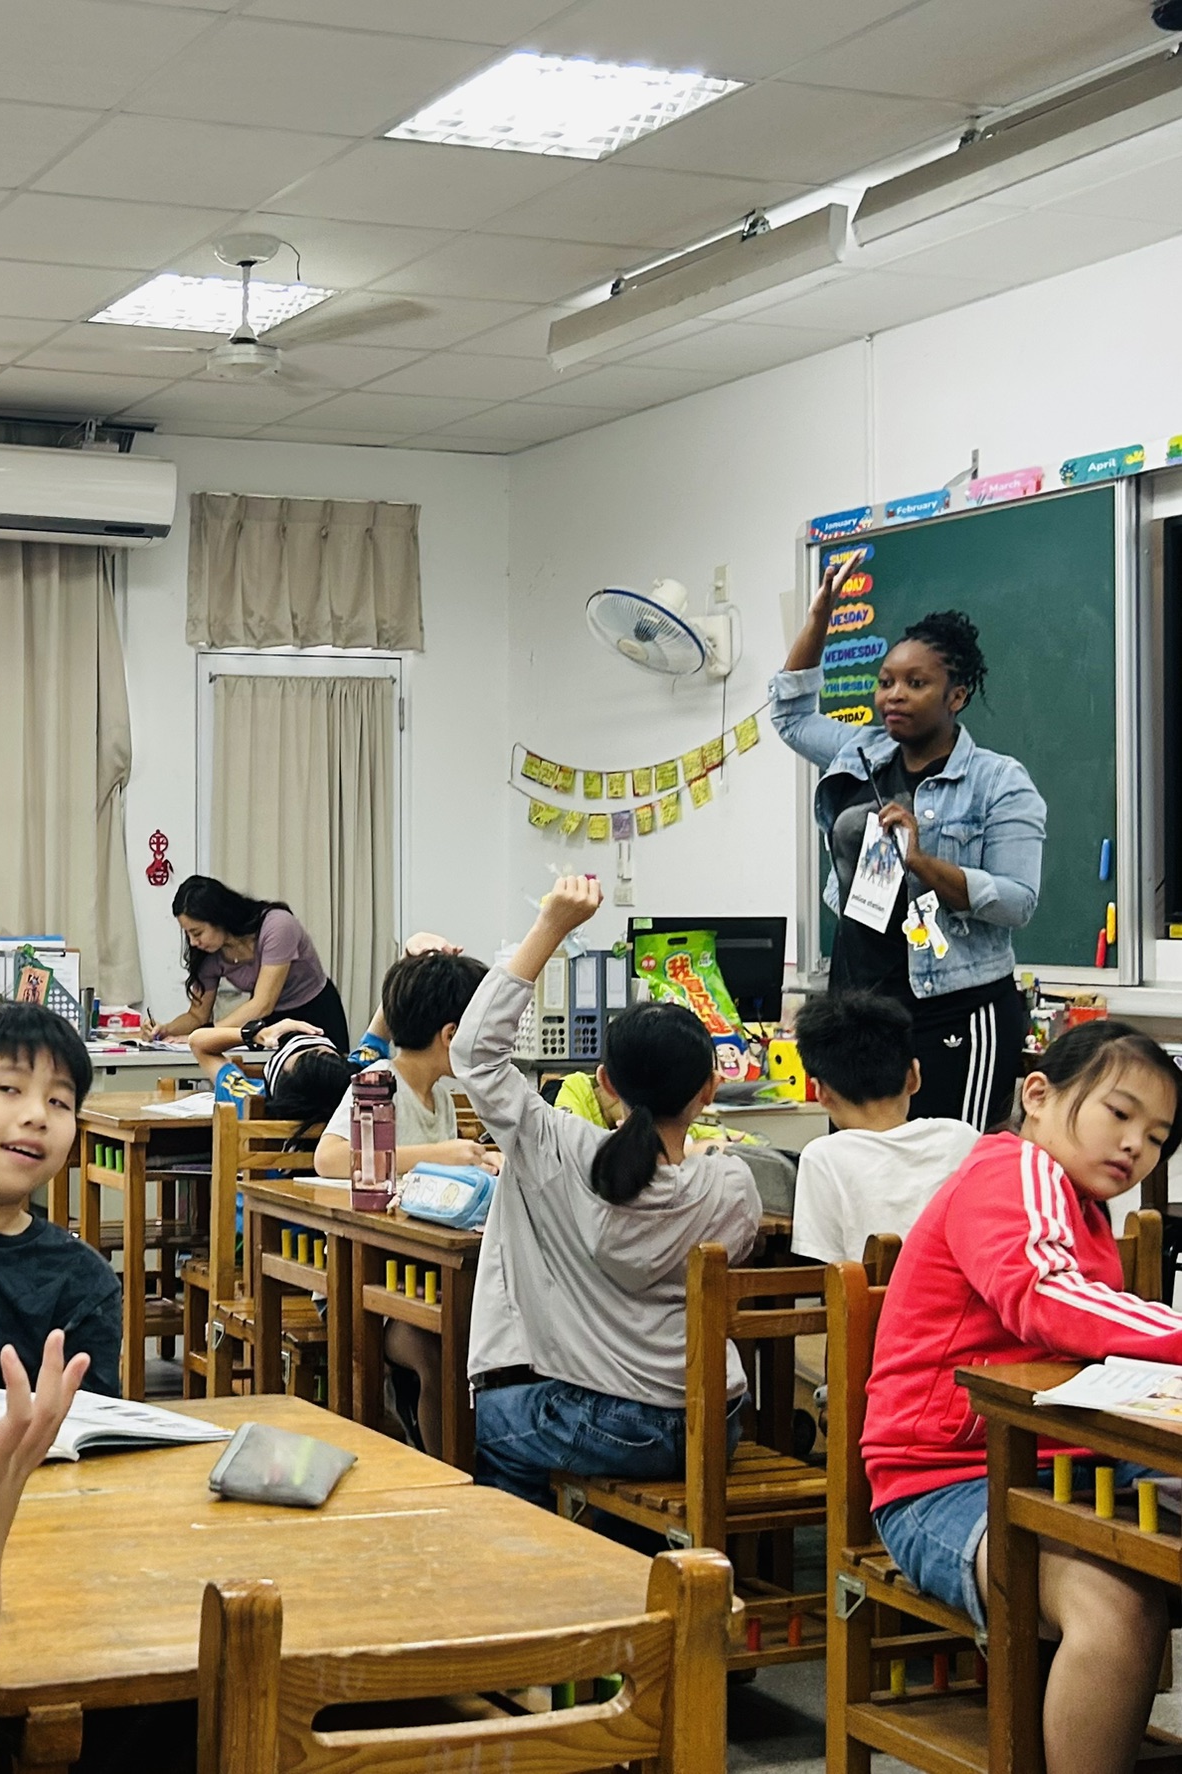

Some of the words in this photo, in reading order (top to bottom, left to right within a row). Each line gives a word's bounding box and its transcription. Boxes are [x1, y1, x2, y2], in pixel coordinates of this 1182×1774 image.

[1087, 457, 1117, 473] April
[988, 479, 1021, 493] March
[896, 500, 938, 515] February
[824, 517, 858, 532] January
[830, 609, 869, 627] UESDAY
[824, 642, 884, 663] WEDNESDAY
[824, 680, 875, 694] THURSDAY
